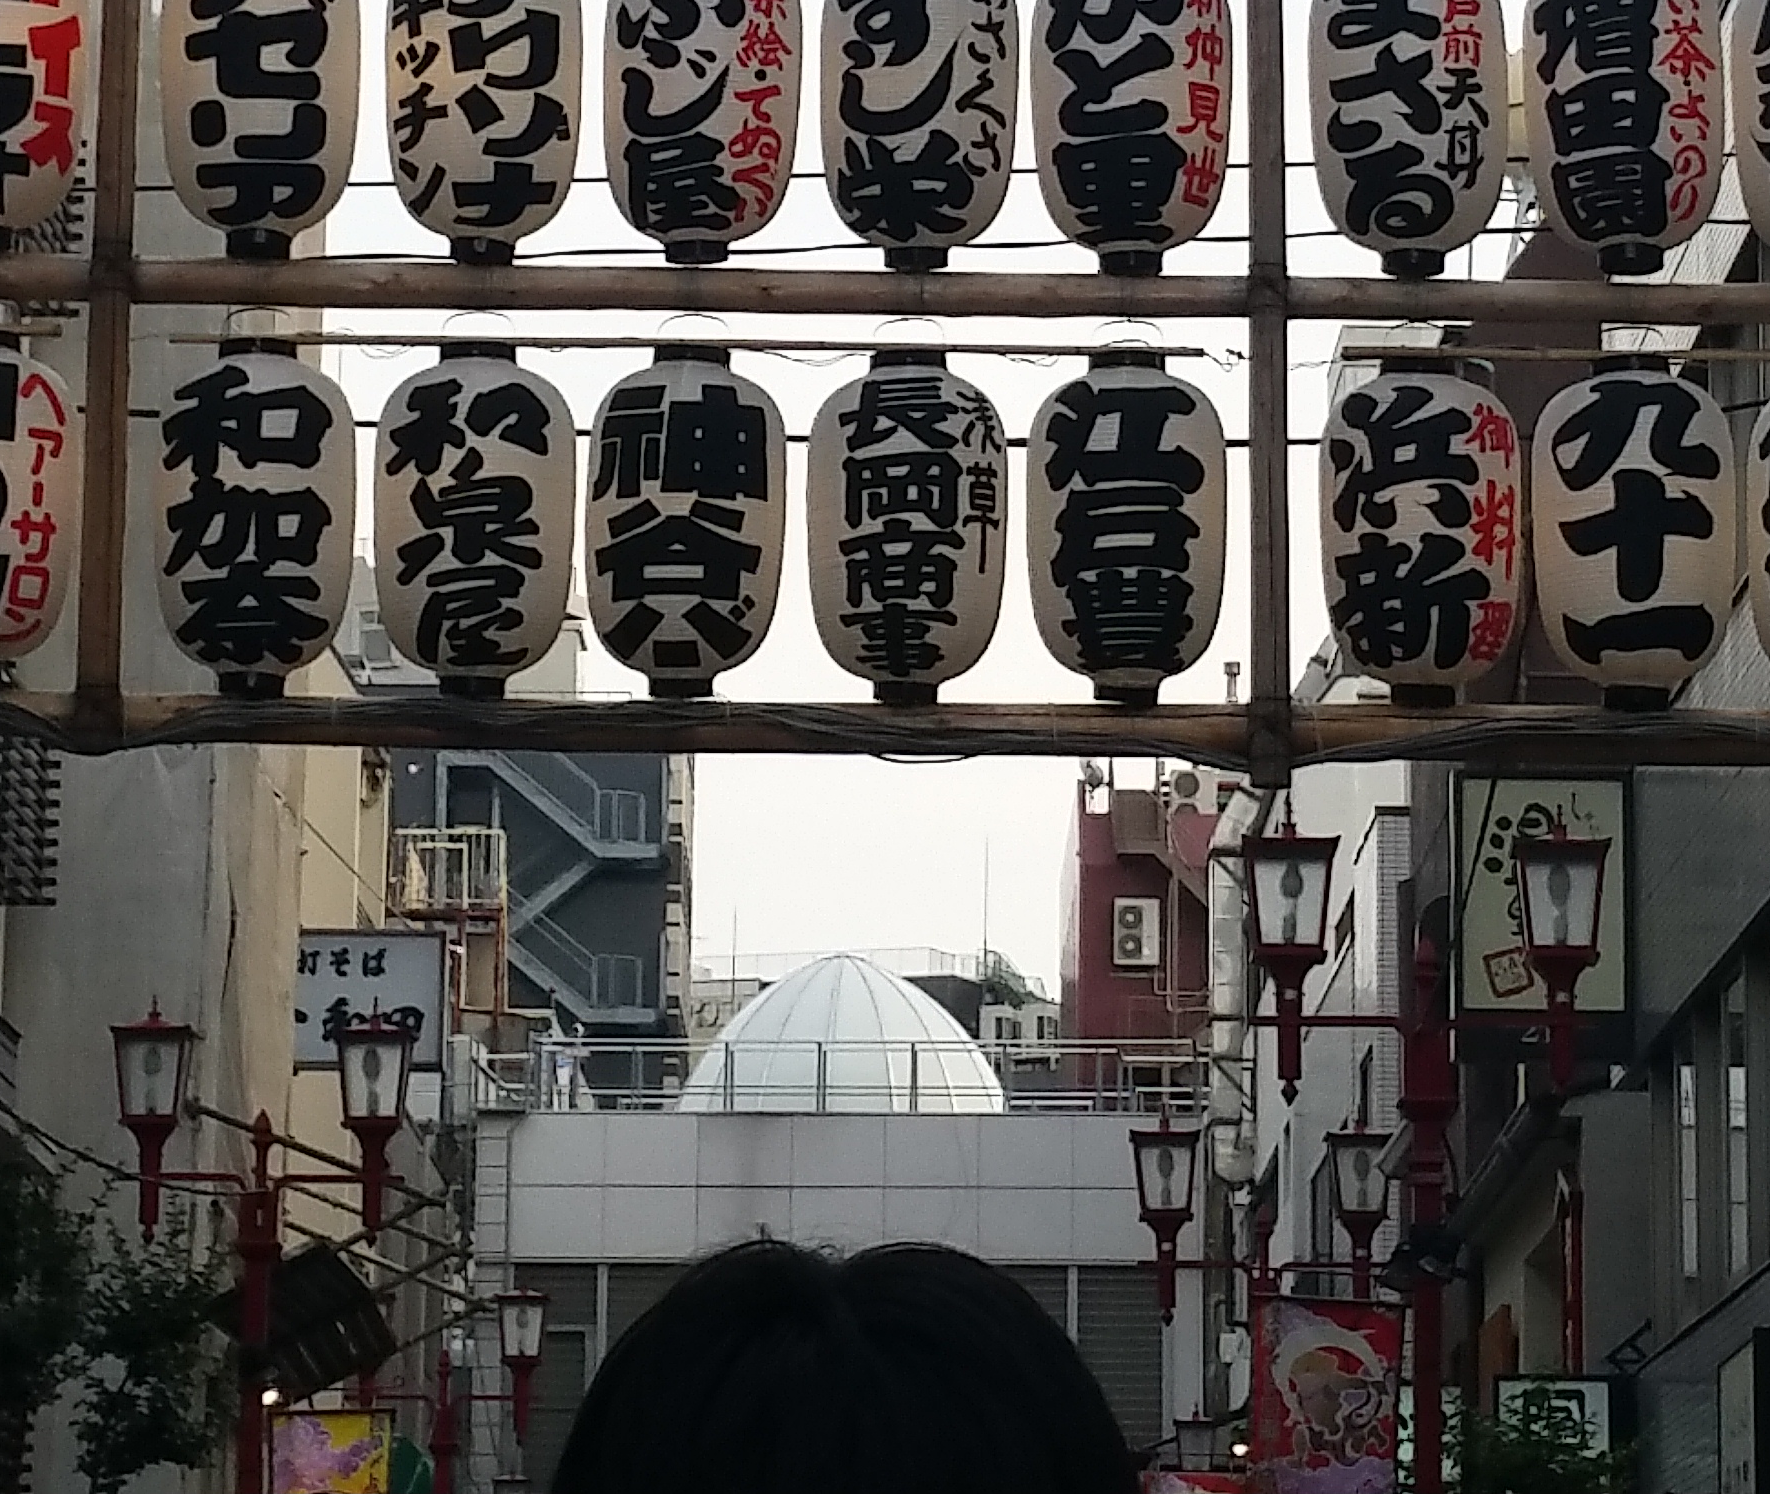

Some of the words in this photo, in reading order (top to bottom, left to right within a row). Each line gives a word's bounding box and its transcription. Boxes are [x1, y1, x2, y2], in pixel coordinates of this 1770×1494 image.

[1436, 70, 1489, 190] 天丼
[171, 367, 334, 664] 和加奈
[388, 380, 552, 667] 和泉屋
[589, 387, 772, 668] 神谷バー
[838, 378, 965, 677] 長岡商事
[957, 393, 1000, 575] 浅草
[1467, 408, 1515, 660] 御料理
